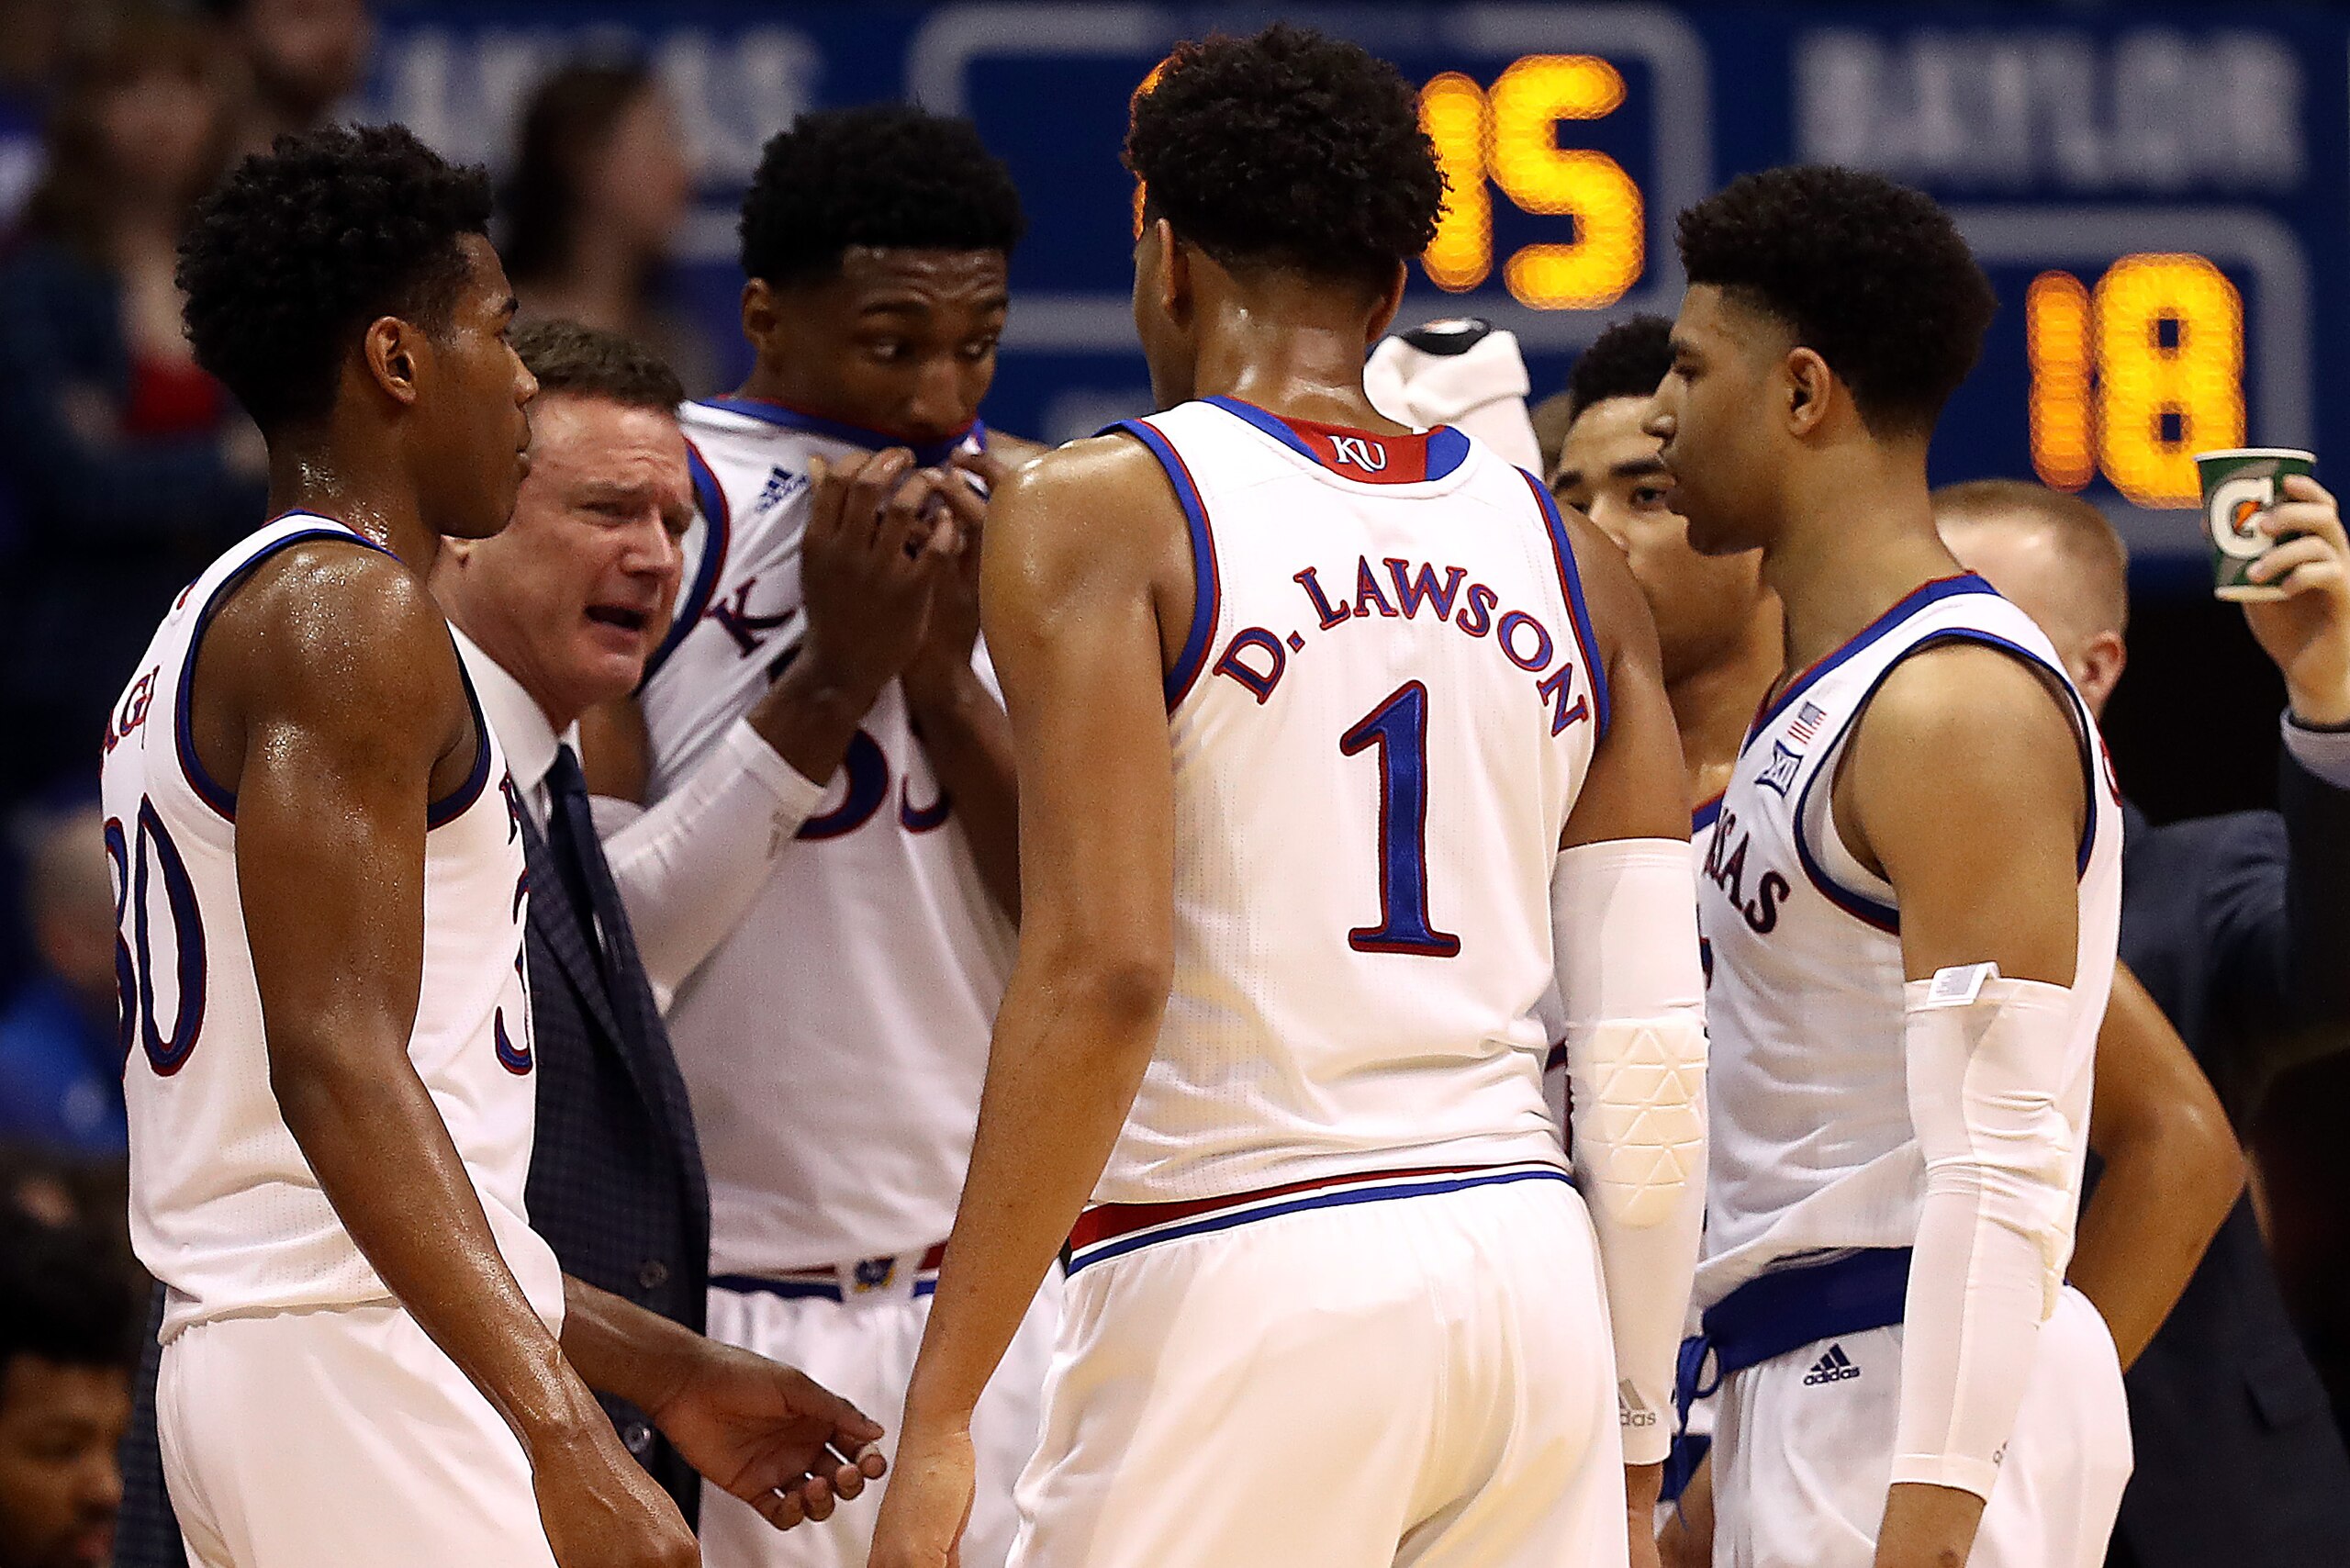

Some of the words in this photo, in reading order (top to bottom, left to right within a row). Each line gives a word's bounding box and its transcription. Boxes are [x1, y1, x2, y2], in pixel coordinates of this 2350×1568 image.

[2025, 252, 2245, 509] 18
[1327, 434, 1387, 473] KU
[2210, 476, 2274, 559] G
[1214, 627, 1305, 705] D.
[1294, 555, 1588, 737] LAWSON
[1339, 679, 1460, 958] 1
[1804, 1367, 1860, 1385] adidas
[1619, 1411, 1656, 1426] das
